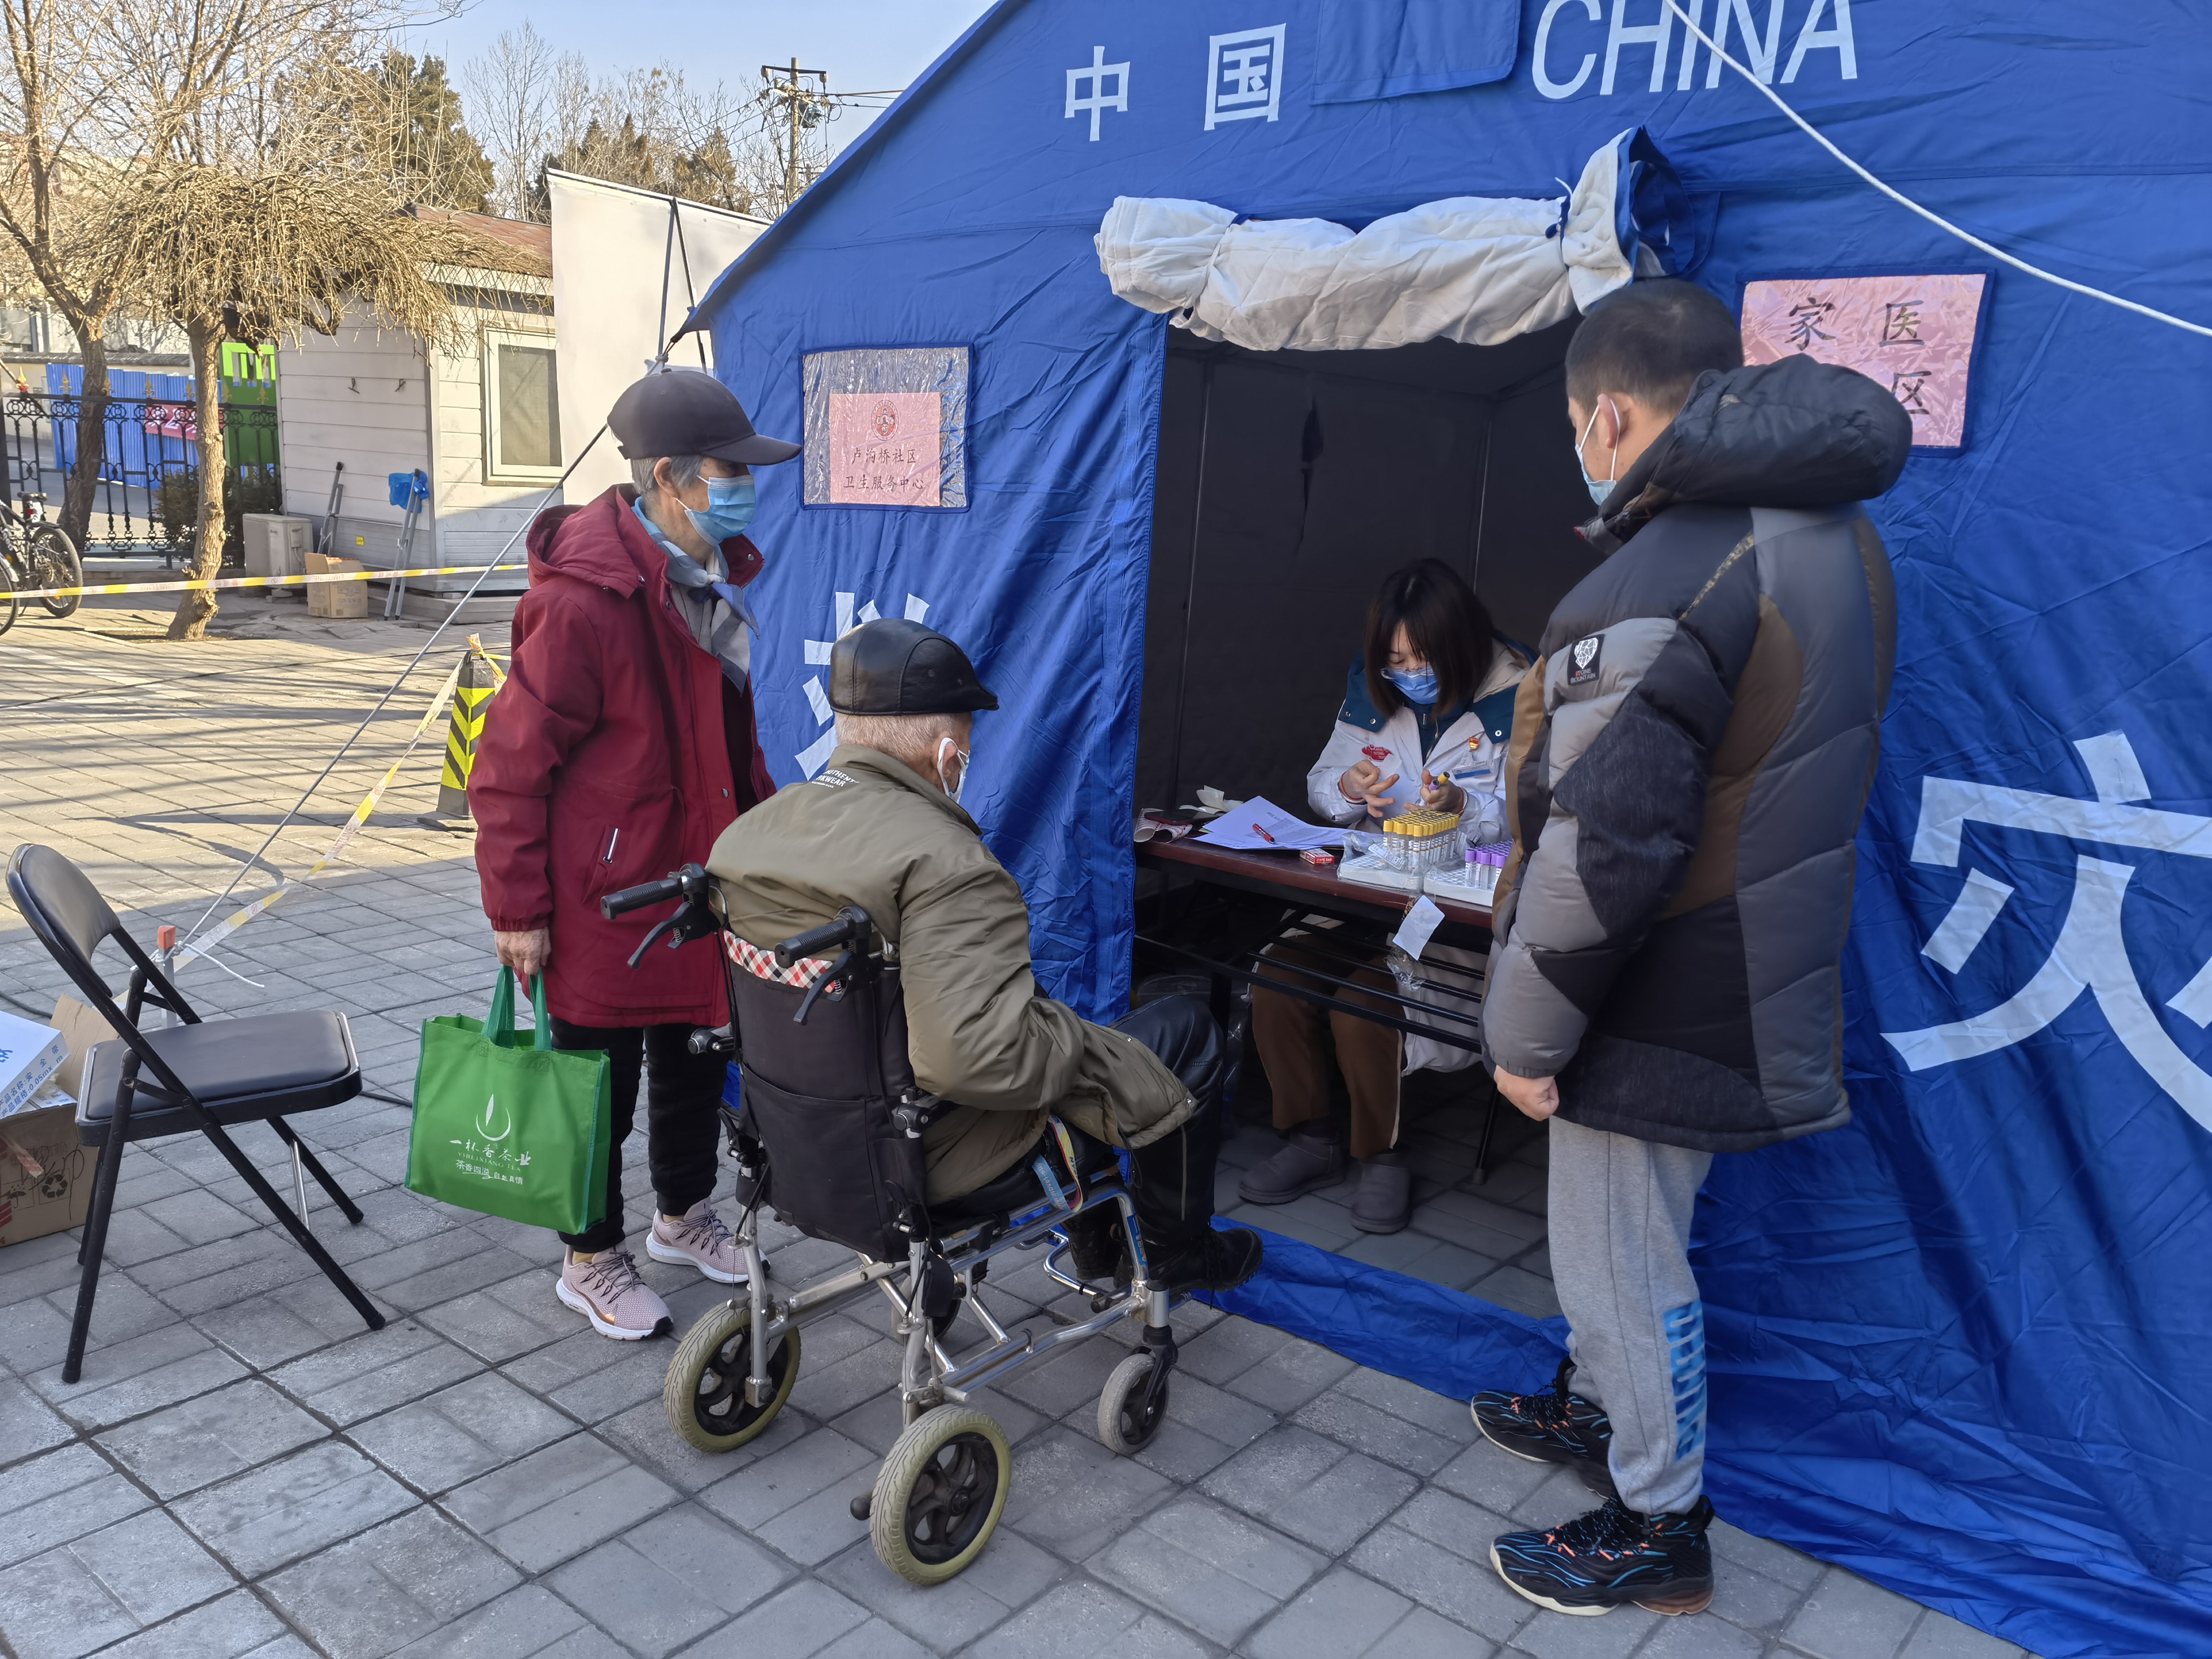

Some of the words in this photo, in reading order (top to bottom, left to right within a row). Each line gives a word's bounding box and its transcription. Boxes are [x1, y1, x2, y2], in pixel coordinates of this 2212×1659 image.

[1532, 0, 1857, 99] CHINA
[1064, 23, 1286, 141] 中国
[1785, 297, 1925, 350] 家医
[851, 448, 917, 464] 卢沟桥社区
[844, 475, 923, 493] 卫生服务中心
